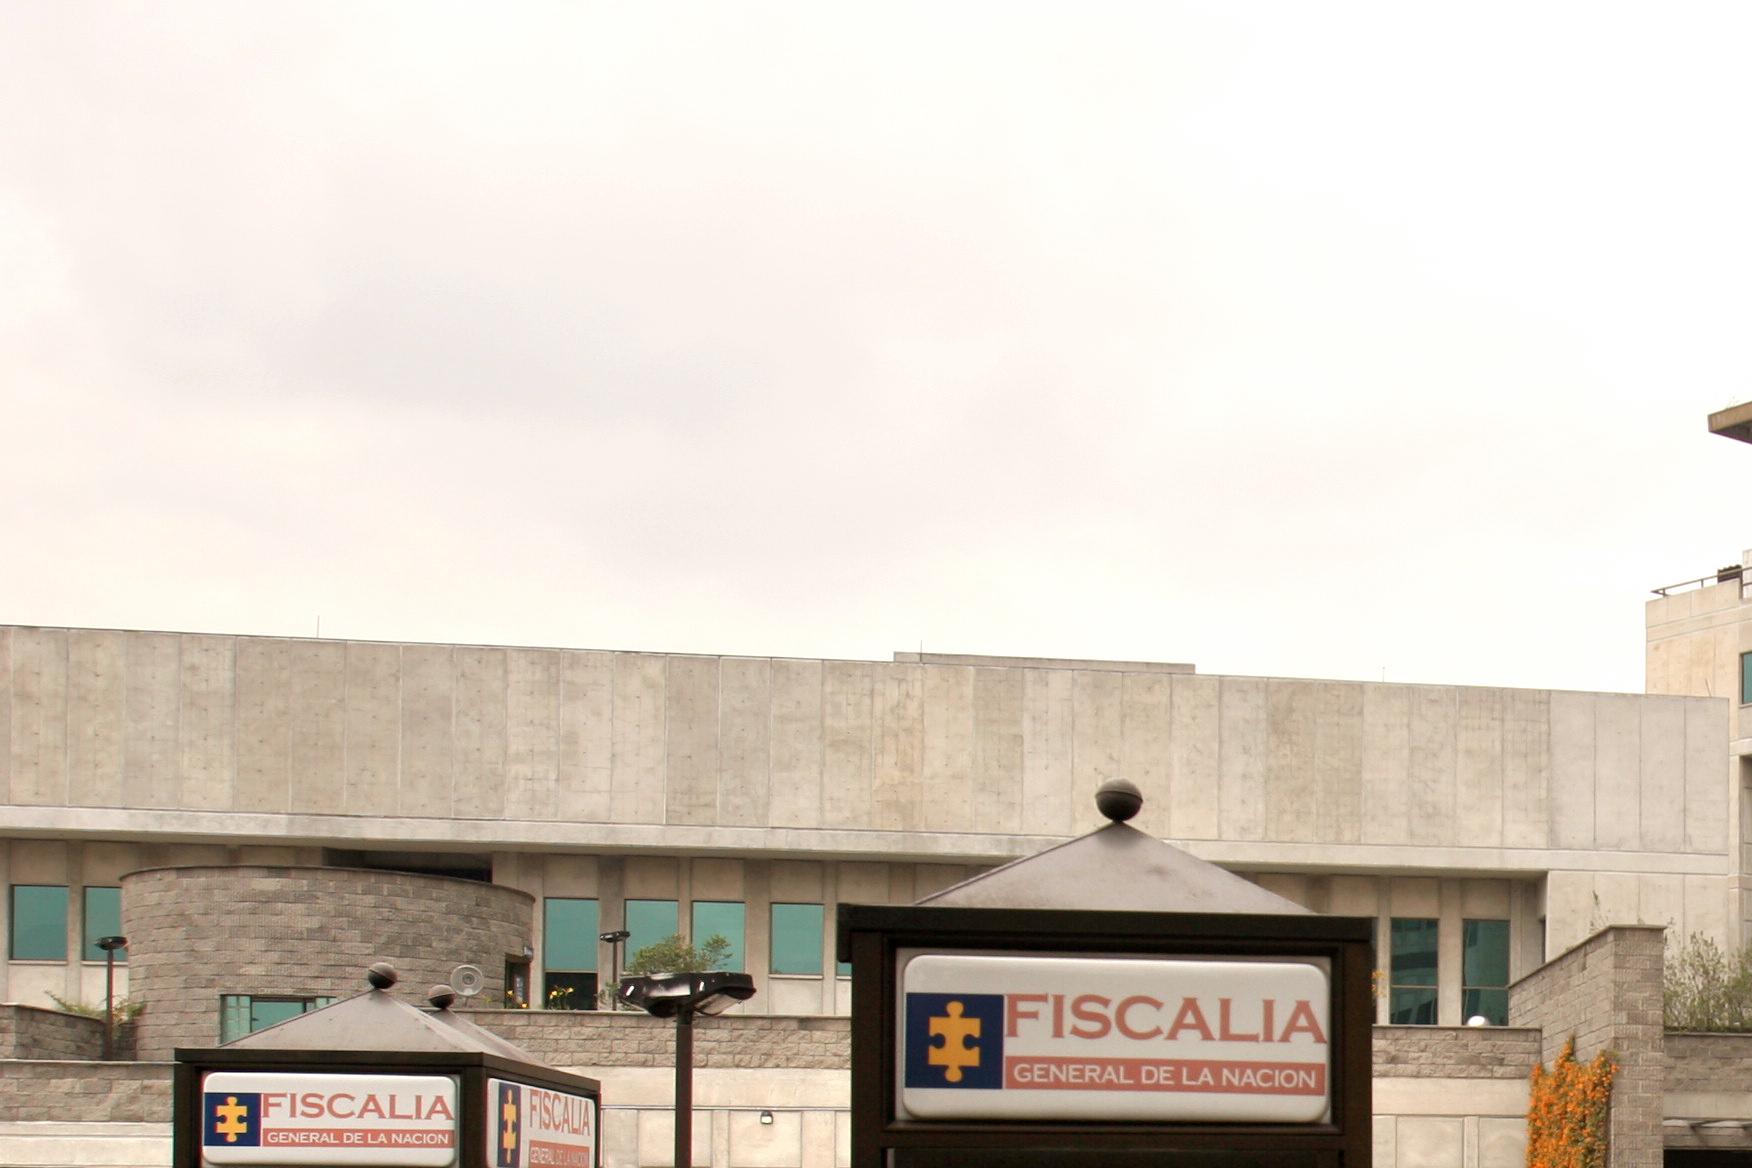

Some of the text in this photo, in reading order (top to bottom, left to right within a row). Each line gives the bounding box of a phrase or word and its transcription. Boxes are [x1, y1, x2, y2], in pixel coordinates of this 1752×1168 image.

[1005, 993, 1327, 1044] FISCALIA
[1014, 1063, 1316, 1088] GENERAL DE LA NACION
[262, 1092, 454, 1120] FISCALIA
[529, 1089, 590, 1136] FISCALIA
[267, 1131, 449, 1145] GENERAL DE LA NACION
[530, 1147, 555, 1165] GENERAL
